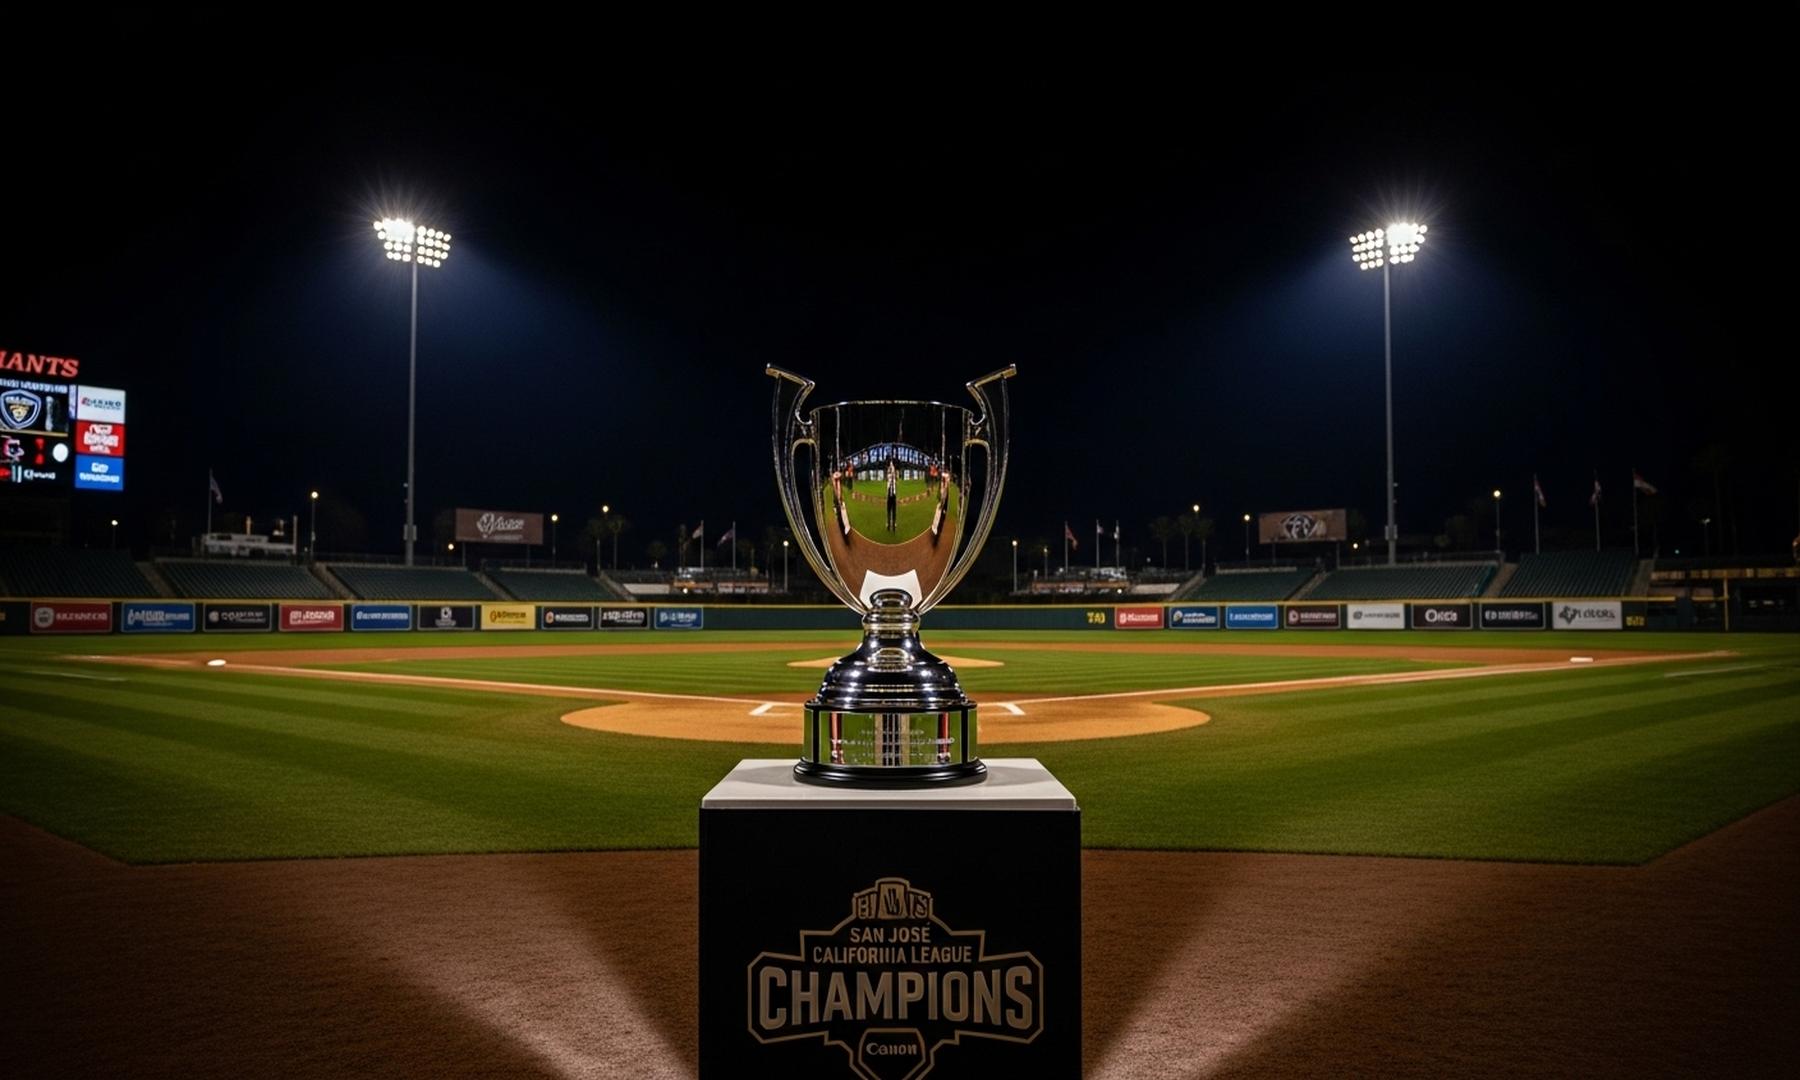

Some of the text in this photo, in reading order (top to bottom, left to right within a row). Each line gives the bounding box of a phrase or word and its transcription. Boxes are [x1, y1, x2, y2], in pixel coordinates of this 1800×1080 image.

[850, 921, 931, 943] SAN JOSÉ
[911, 946, 972, 964] LEAGUE
[759, 965, 1033, 1030] CHAMPIONS
